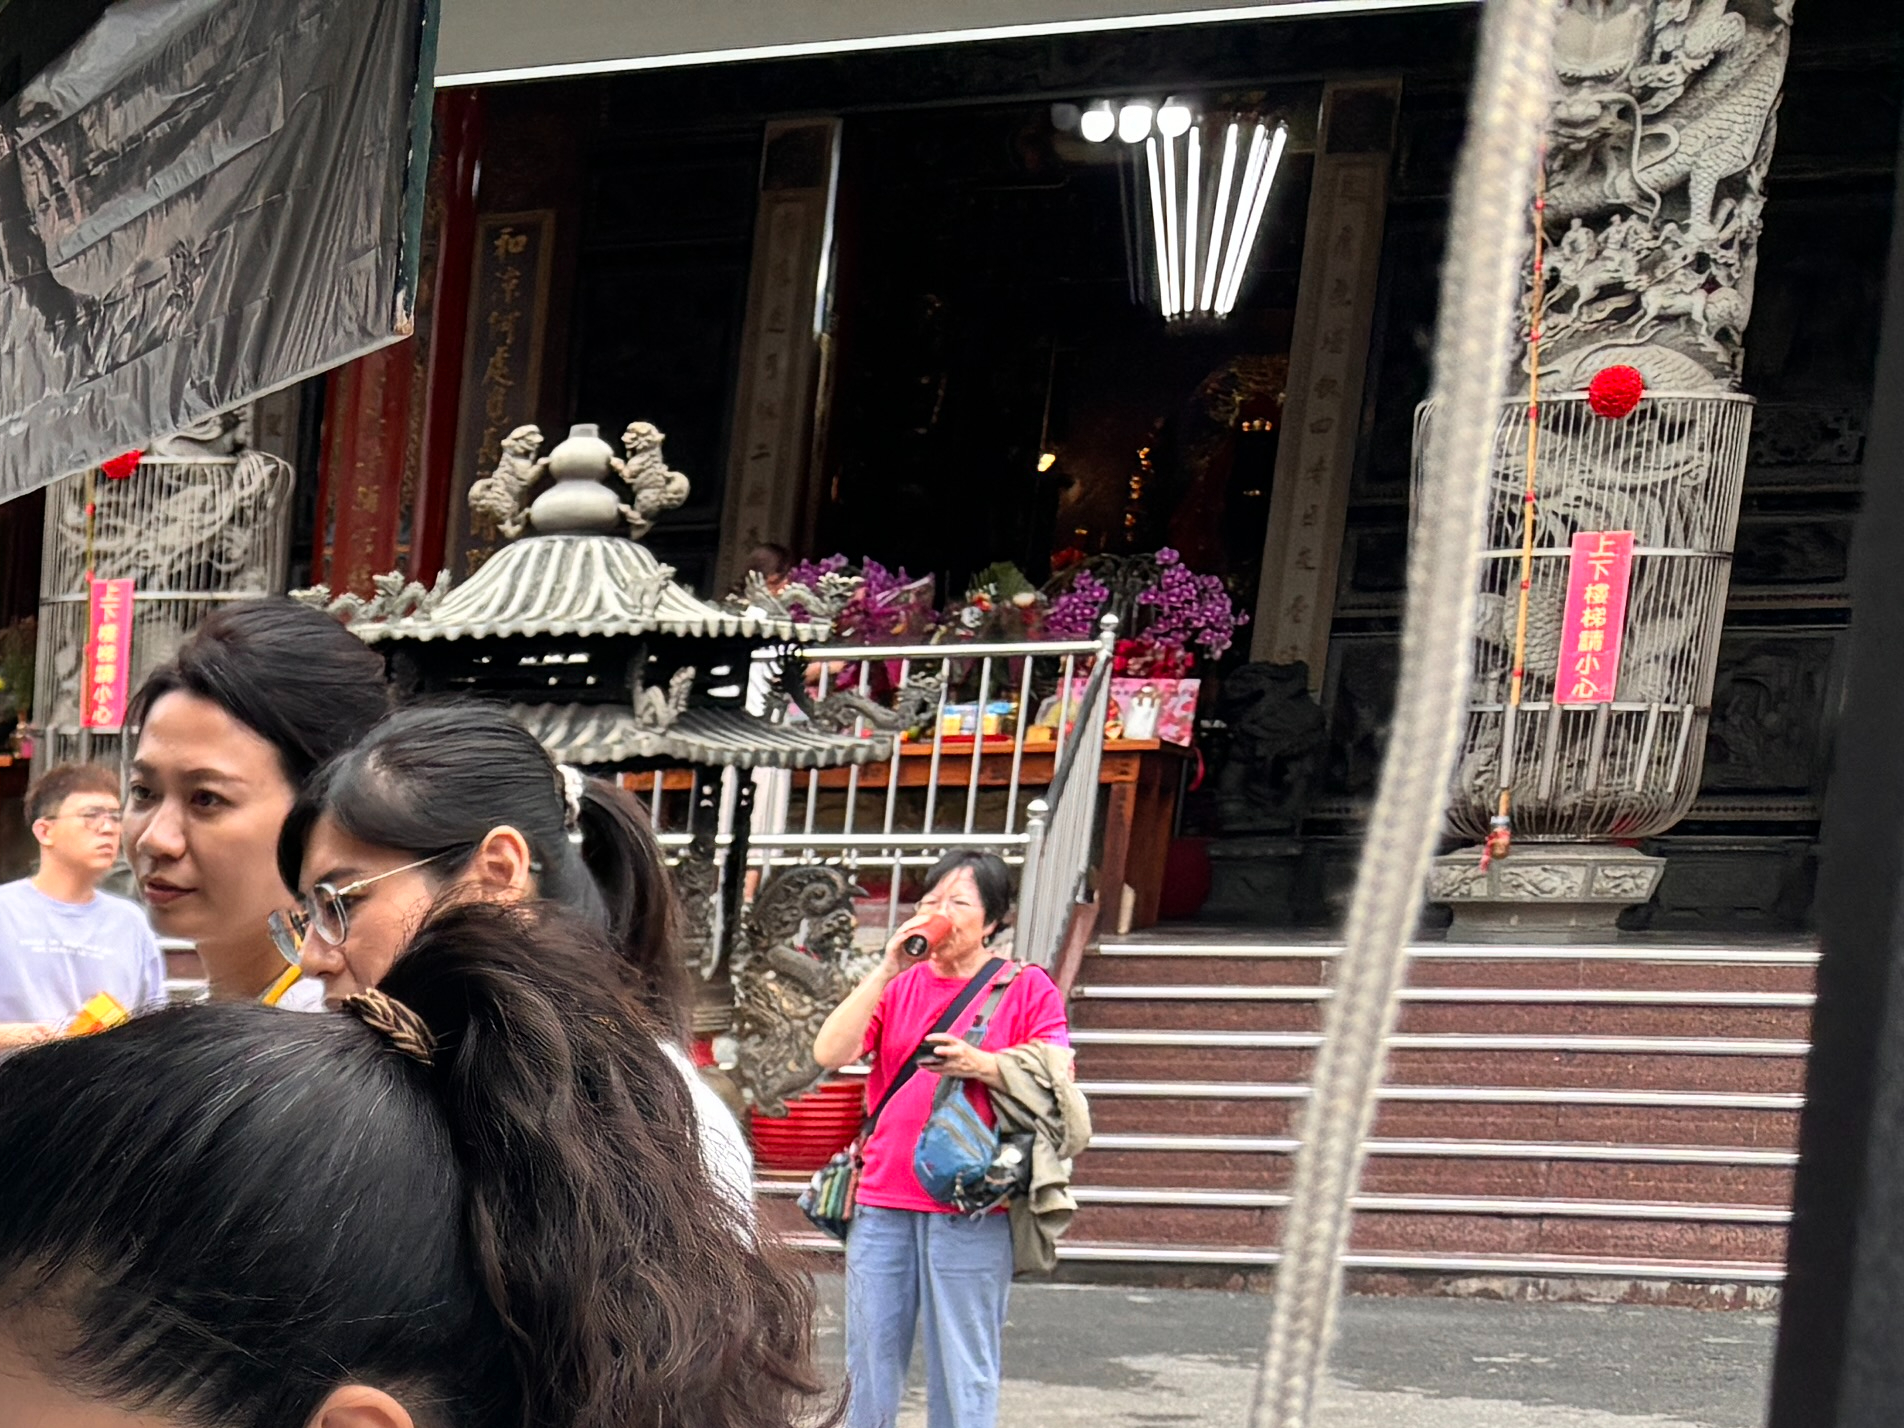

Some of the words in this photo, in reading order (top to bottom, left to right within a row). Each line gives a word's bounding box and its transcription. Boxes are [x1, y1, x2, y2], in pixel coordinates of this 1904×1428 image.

[1570, 534, 1616, 699] 上下樓梯請小心
